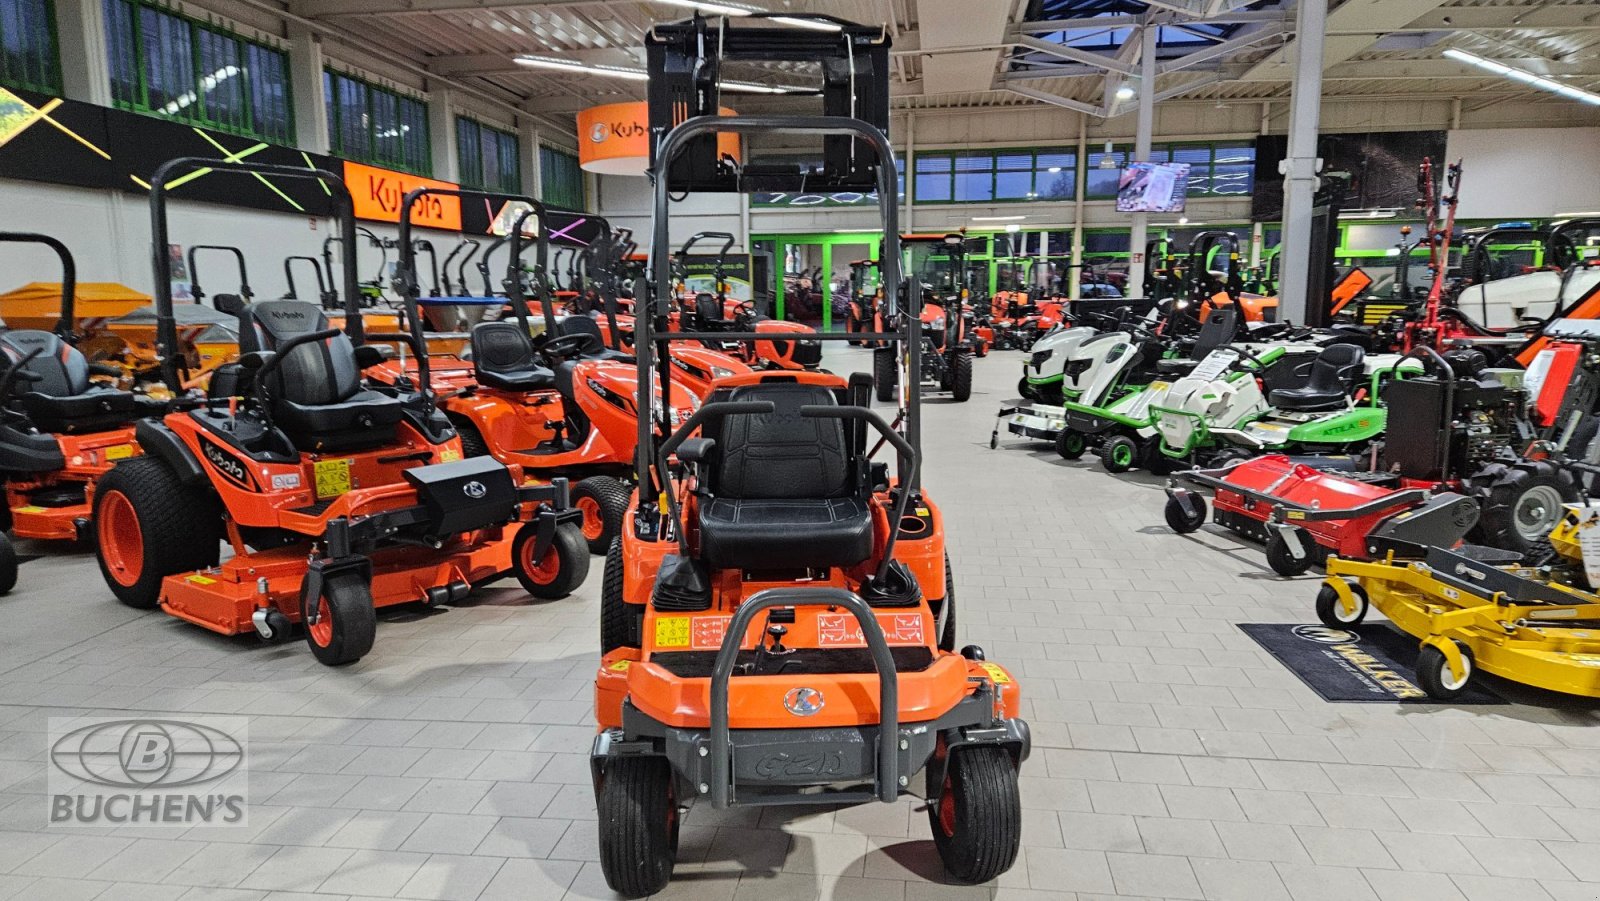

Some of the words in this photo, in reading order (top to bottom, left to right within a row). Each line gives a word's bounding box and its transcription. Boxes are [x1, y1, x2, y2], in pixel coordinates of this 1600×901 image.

[611, 121, 649, 138] Kub
[1323, 423, 1356, 436] ATTILA
[204, 442, 244, 480] Kubota
[1330, 643, 1429, 699] WALKER
